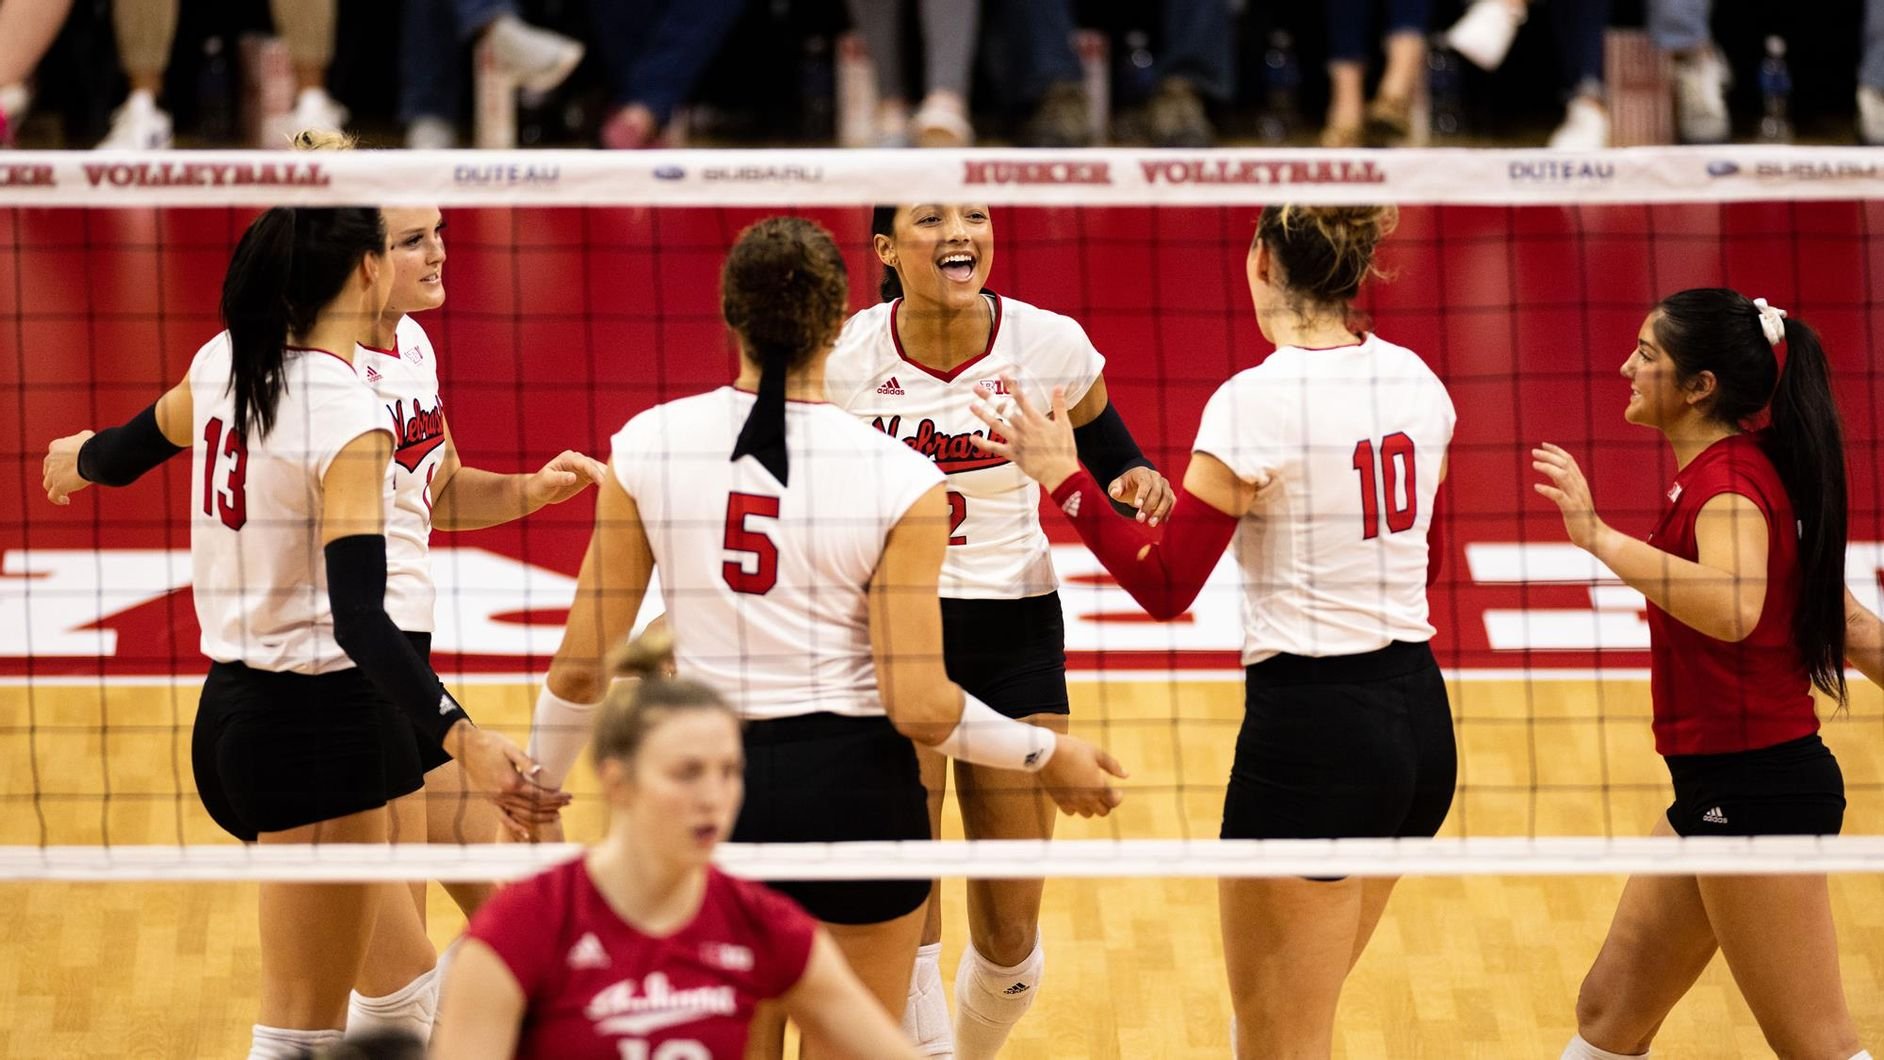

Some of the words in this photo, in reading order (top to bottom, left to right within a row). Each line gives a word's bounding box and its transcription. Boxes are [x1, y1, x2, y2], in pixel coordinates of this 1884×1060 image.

[0, 164, 57, 187] ER
[83, 162, 330, 187] VOLLEYBALL
[454, 164, 559, 184] DUTEAU
[701, 164, 824, 182] SUBARU
[964, 161, 1111, 185] HUSKER
[1140, 161, 1386, 185] VOLLEYBALL
[1509, 161, 1615, 180] DUTEAU
[877, 387, 905, 396] adidas
[204, 416, 248, 531] 13
[1353, 431, 1416, 540] 10
[722, 490, 780, 596] 5
[1703, 814, 1728, 825] adidas
